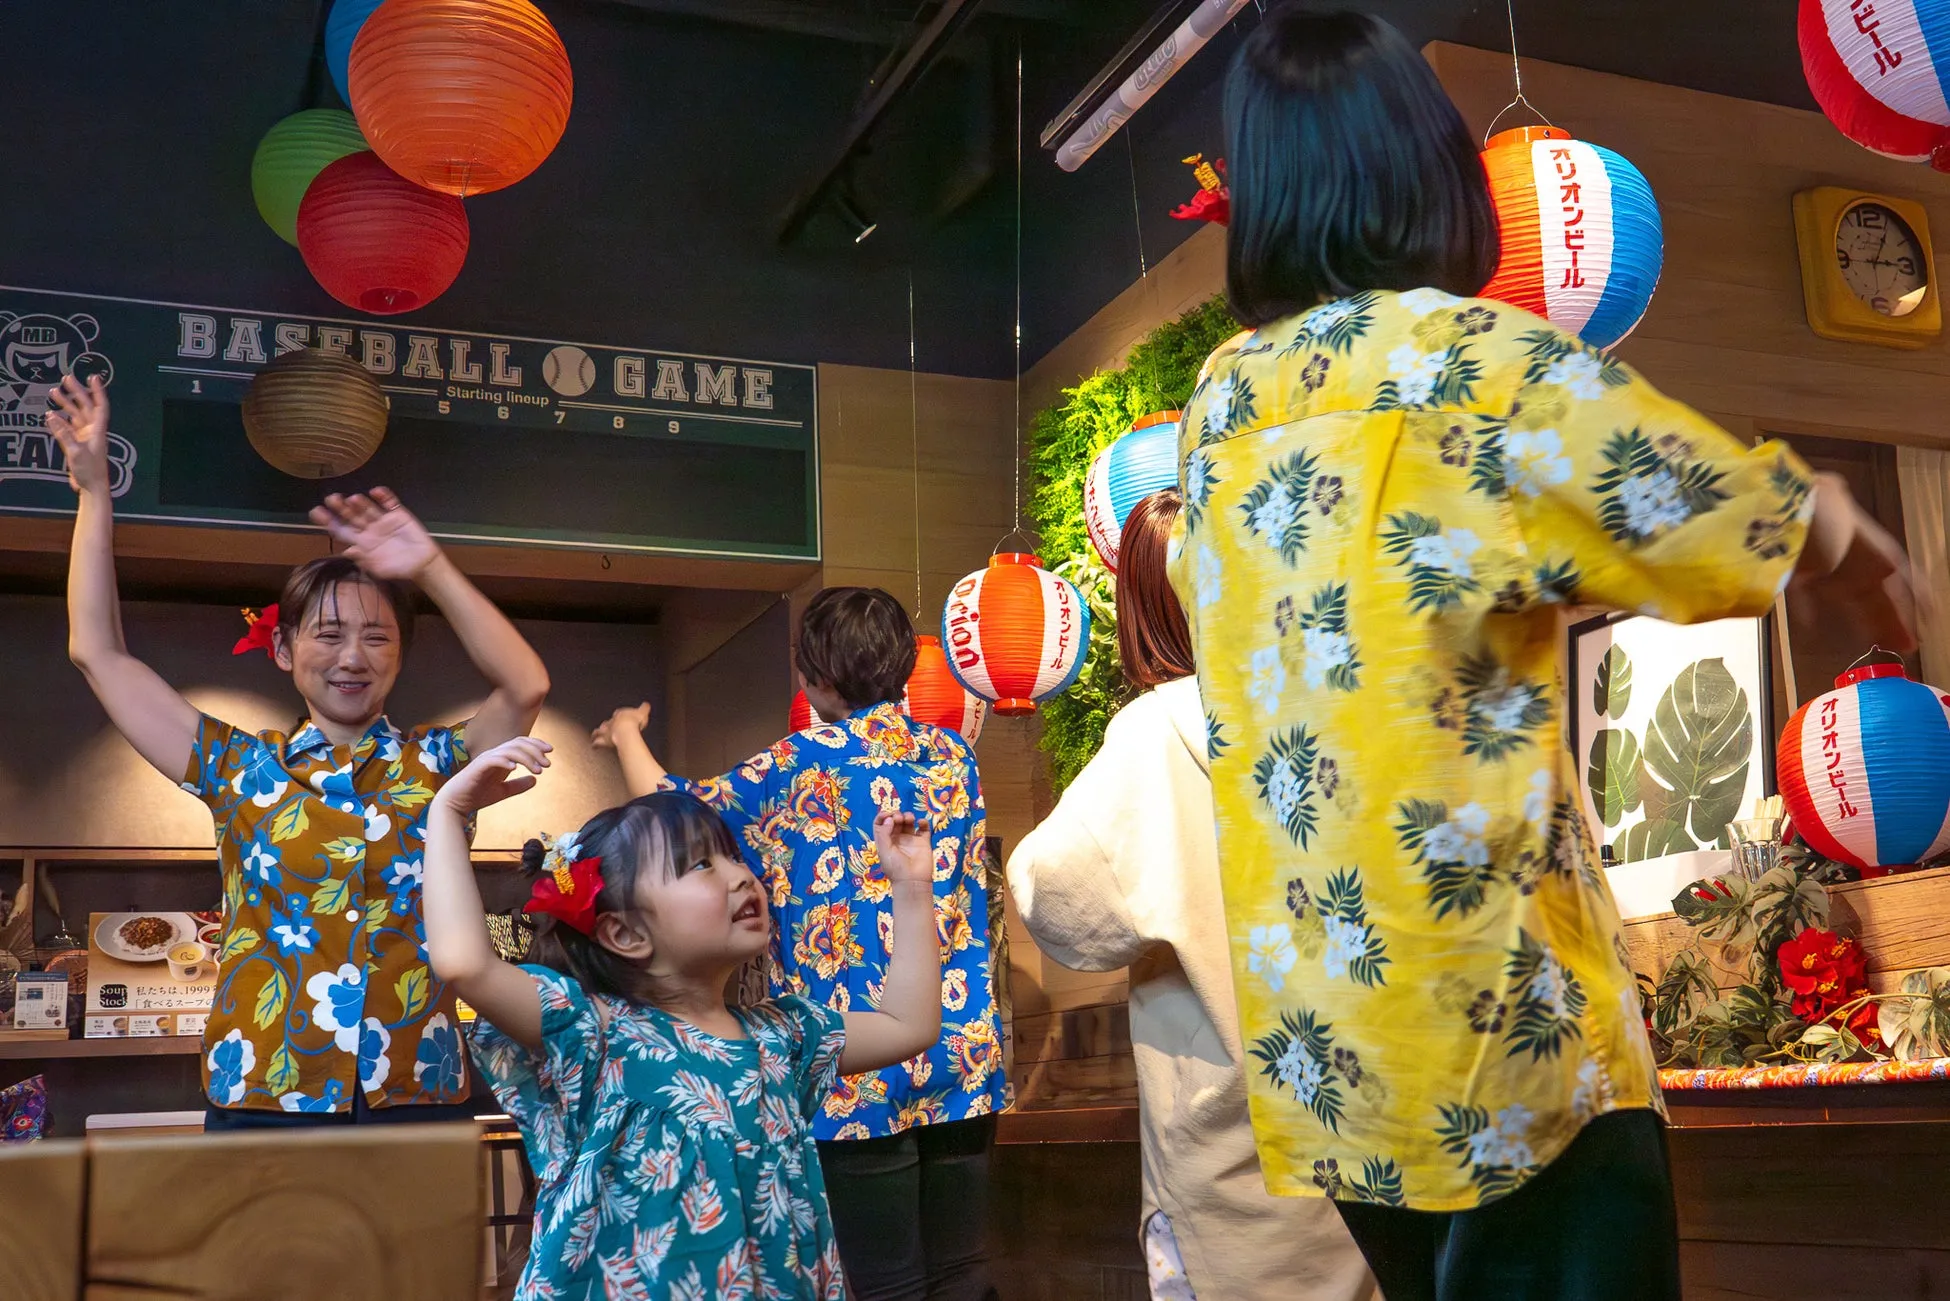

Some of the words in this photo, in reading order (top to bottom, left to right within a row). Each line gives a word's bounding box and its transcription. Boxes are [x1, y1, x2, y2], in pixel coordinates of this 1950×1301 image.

[1850, 0, 1902, 76] ビール
[1549, 148, 1585, 289] オリオンビール
[1856, 208, 1883, 229] 12
[1897, 257, 1916, 276] 3
[23, 327, 56, 343] MB
[177, 312, 522, 387] BASEBALL
[613, 355, 774, 410] GAME
[191, 379, 202, 394] 1
[438, 401, 451, 415] 5
[497, 406, 510, 420] 6
[553, 410, 567, 424] 7
[612, 416, 625, 430] 8
[667, 420, 680, 434] 9
[447, 386, 502, 403] Starting
[506, 390, 550, 408] lineup
[1050, 581, 1072, 670] オリオンビール
[1820, 698, 1859, 820] オリオンビール
[100, 985, 127, 998] Soup
[100, 997, 127, 1008] Stock
